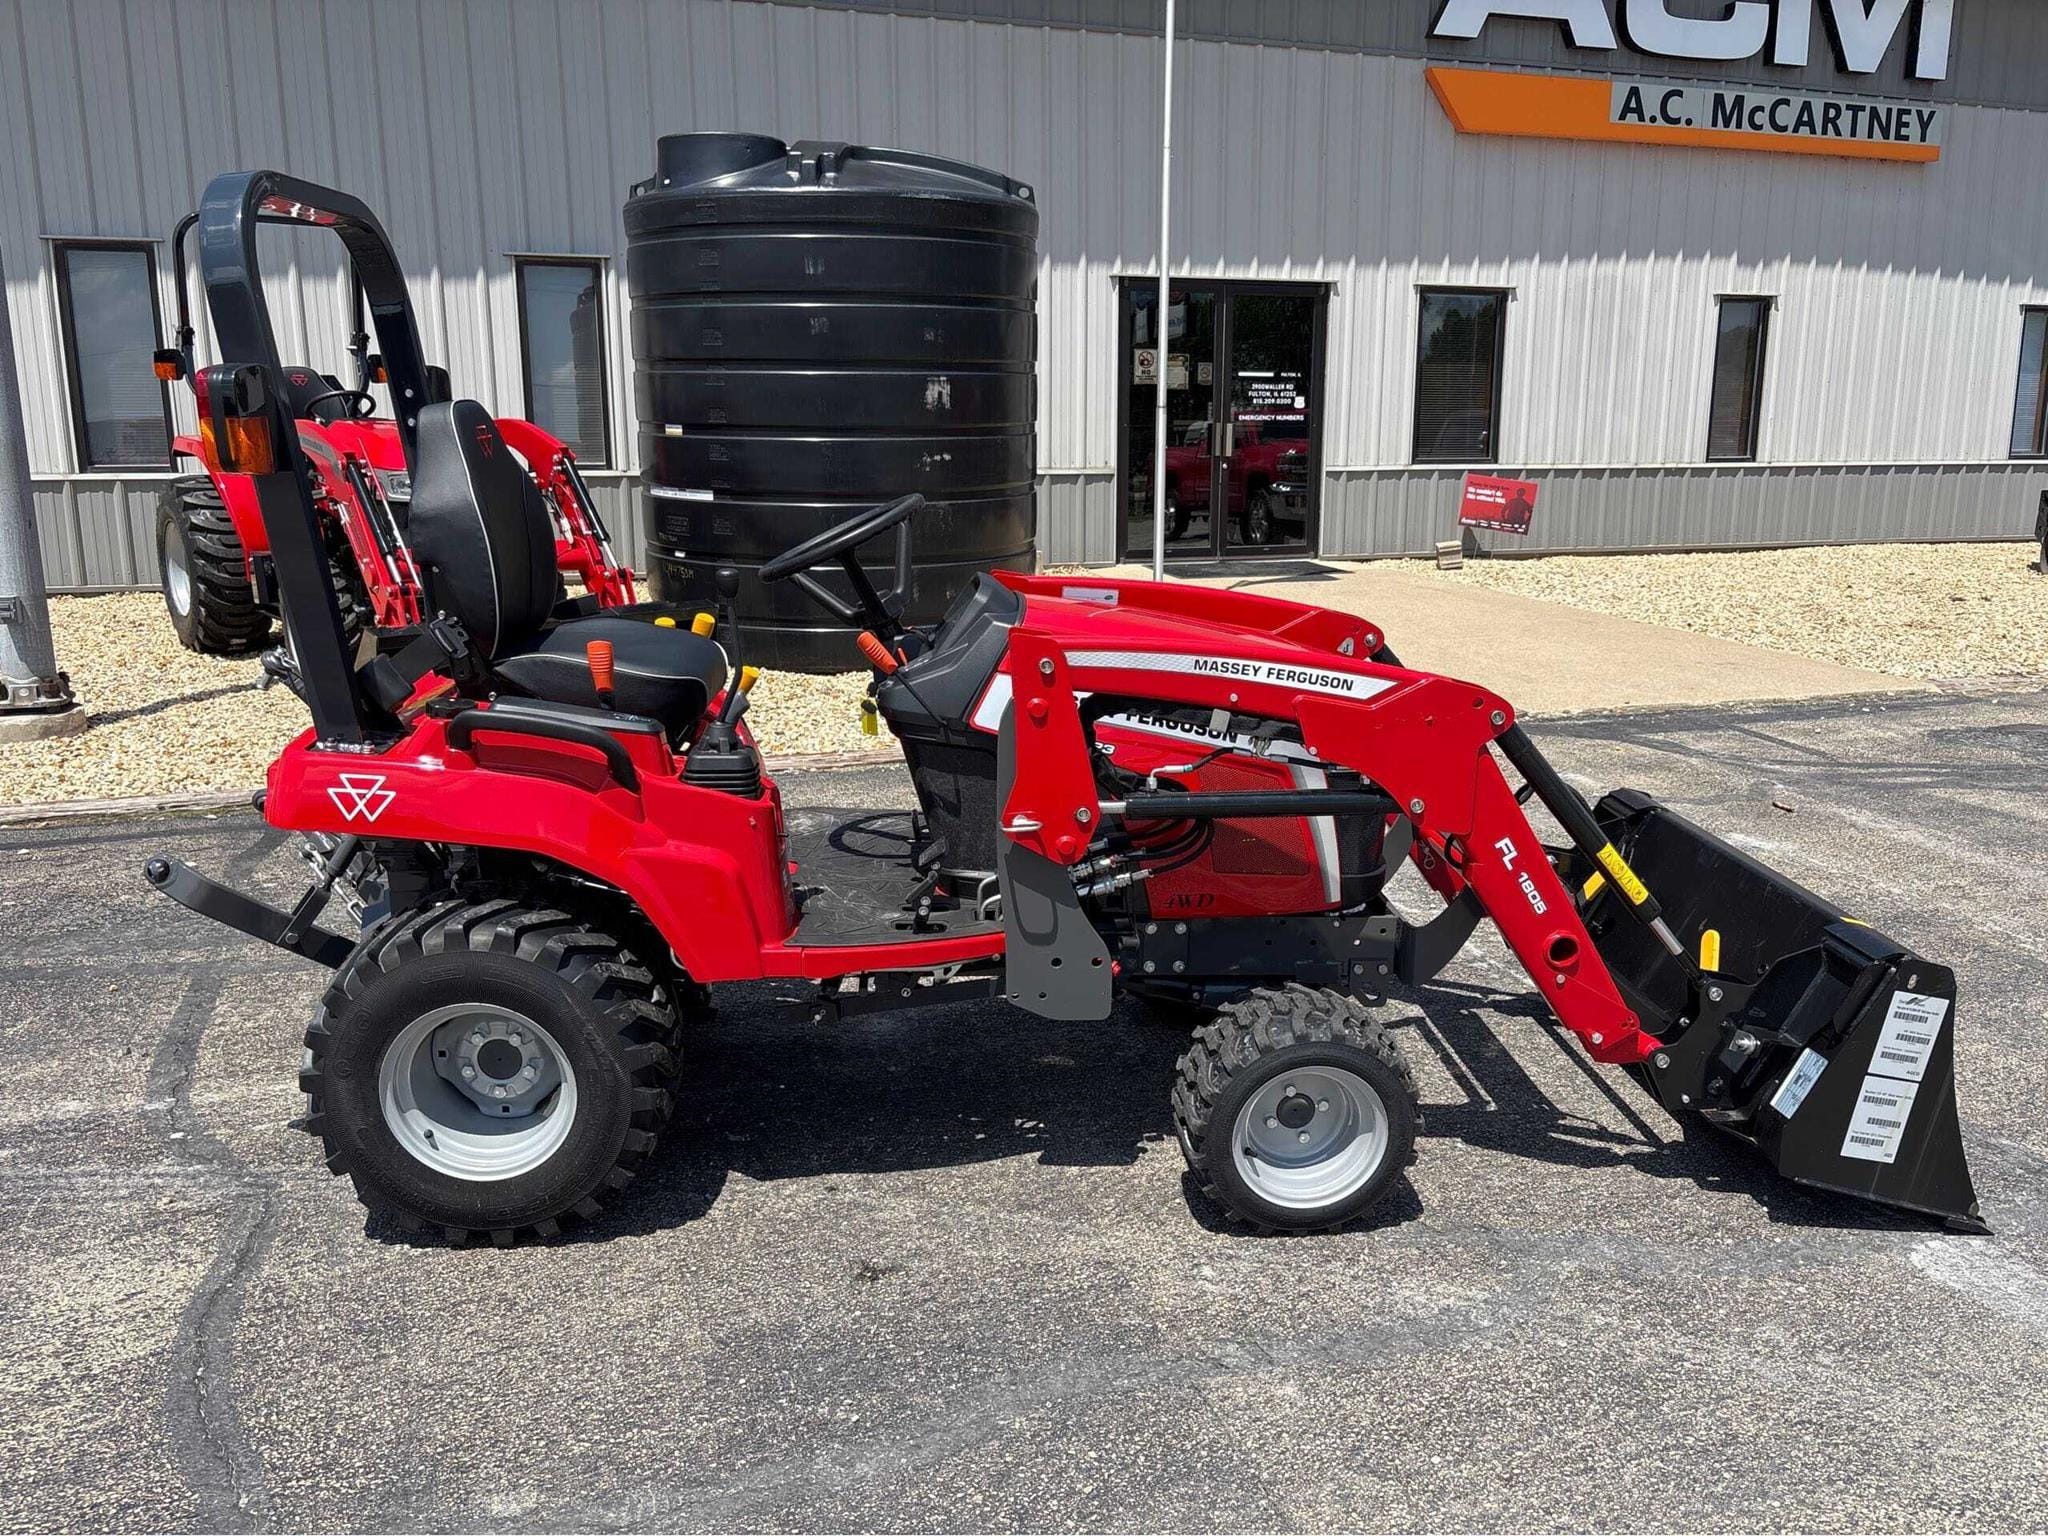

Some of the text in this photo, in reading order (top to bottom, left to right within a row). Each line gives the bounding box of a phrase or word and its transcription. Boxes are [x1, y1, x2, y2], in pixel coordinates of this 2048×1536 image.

[1618, 86, 1937, 143] A.C. McCARTNEY
[1193, 659, 1354, 691] MASSEY FERGUSON
[1494, 837, 1547, 915] FL 1805
